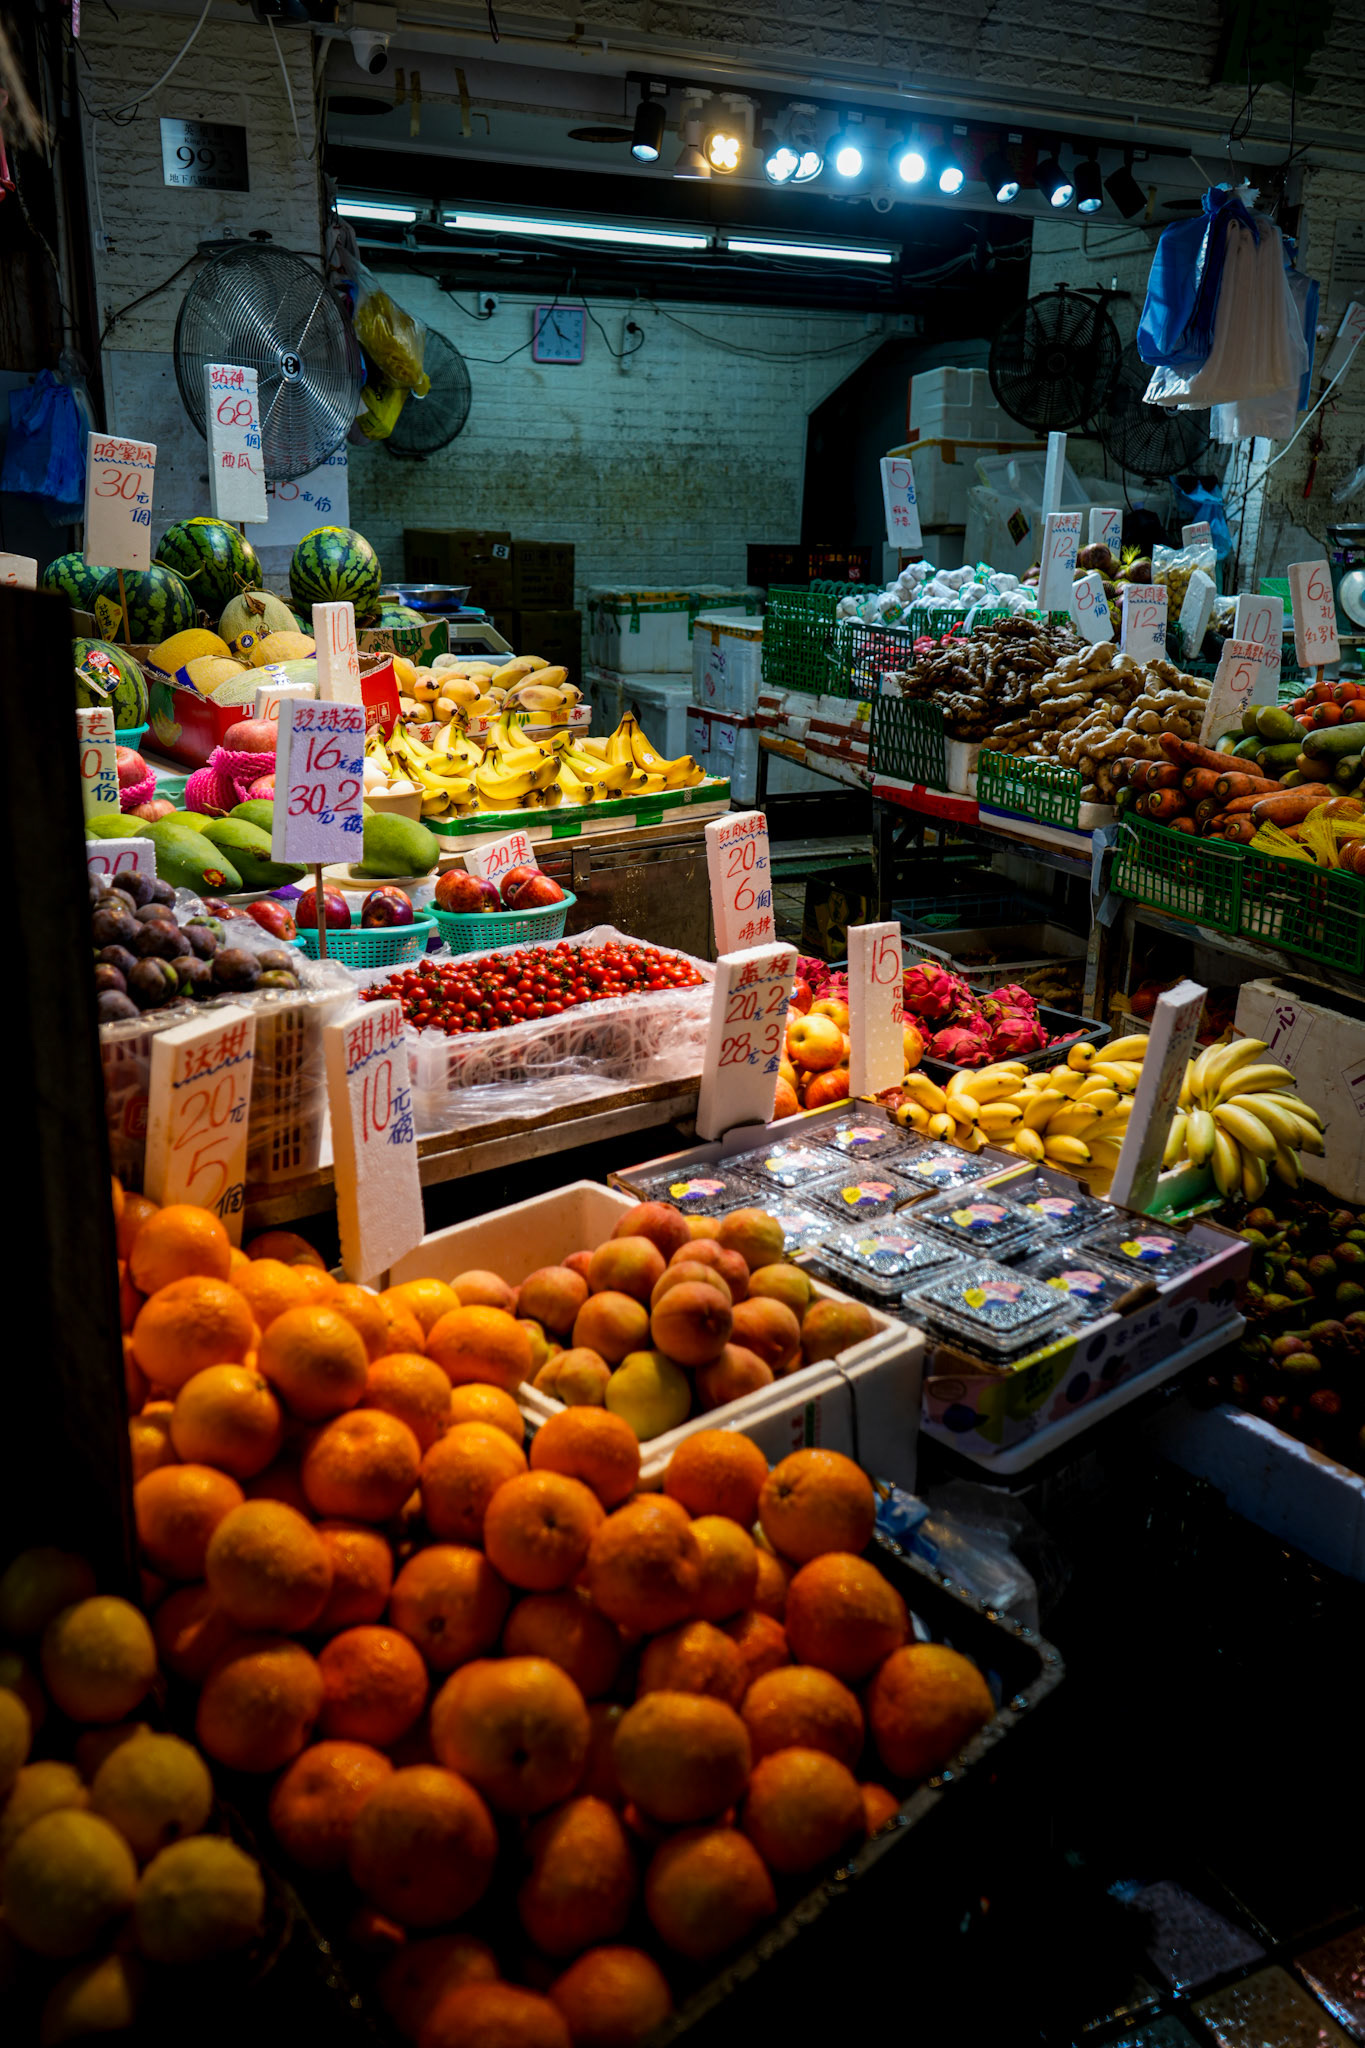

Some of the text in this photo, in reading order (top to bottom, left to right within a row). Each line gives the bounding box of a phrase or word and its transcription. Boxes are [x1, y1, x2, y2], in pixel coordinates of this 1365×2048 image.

[176, 145, 236, 175] 993
[217, 396, 253, 427] 68
[221, 451, 257, 475] 西瓜
[890, 461, 911, 489] 5
[94, 469, 142, 500] 30
[1101, 511, 1117, 535] 7
[1053, 536, 1073, 559] 12
[1075, 581, 1095, 611] 8
[1307, 568, 1325, 601] 6
[331, 607, 350, 655] 10
[1133, 606, 1158, 628] 12
[1242, 609, 1272, 644] 10
[1229, 662, 1253, 692] 5
[306, 736, 342, 773] 16
[288, 784, 326, 817] 30
[484, 836, 529, 874] 加果
[727, 841, 756, 878] 20
[734, 877, 755, 911] 6
[872, 934, 899, 984] 15
[724, 991, 758, 1024] 20
[718, 1032, 751, 1067] 28
[173, 1074, 236, 1151] 20
[362, 1059, 393, 1144] 10
